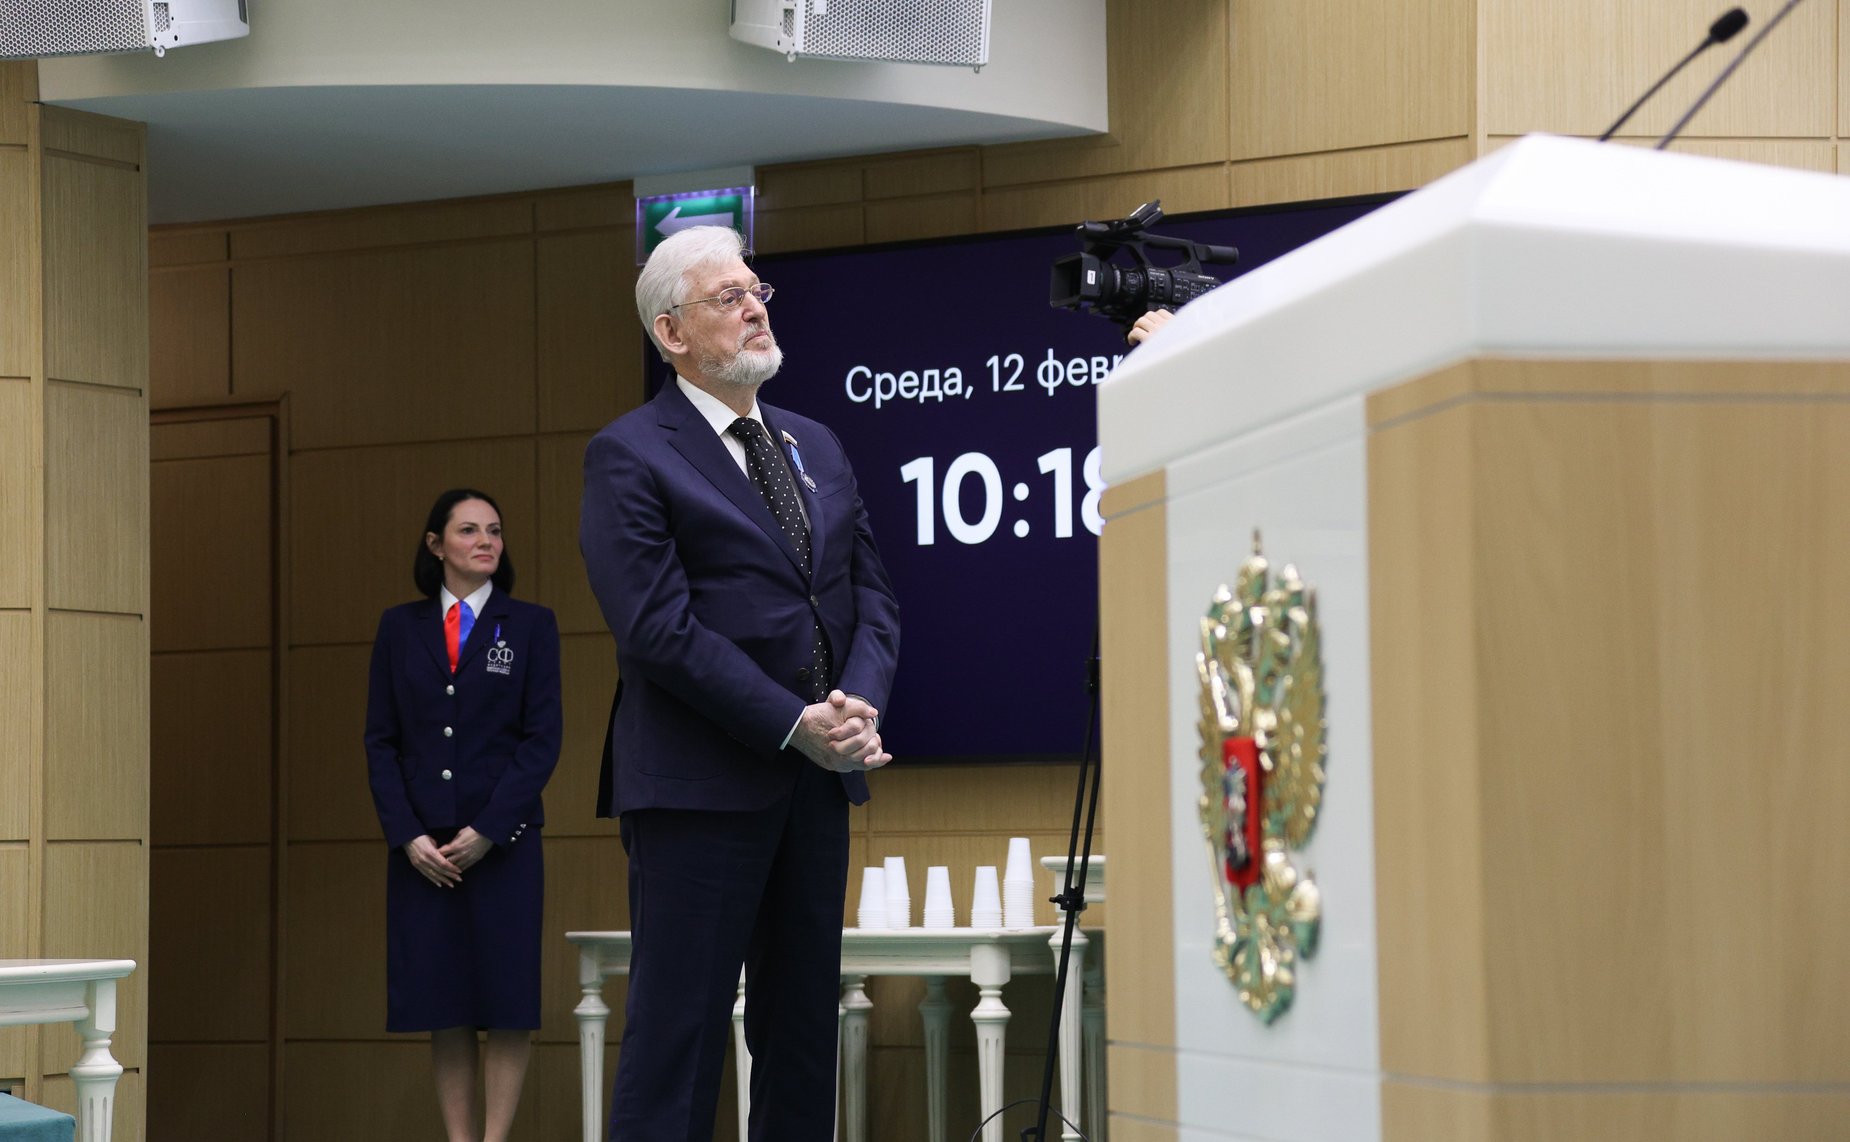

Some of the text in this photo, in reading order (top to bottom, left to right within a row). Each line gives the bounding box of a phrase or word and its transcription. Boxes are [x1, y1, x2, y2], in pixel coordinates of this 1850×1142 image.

[845, 366, 974, 409] Среда,
[986, 354, 1025, 392] 12
[487, 647, 514, 663] СФ
